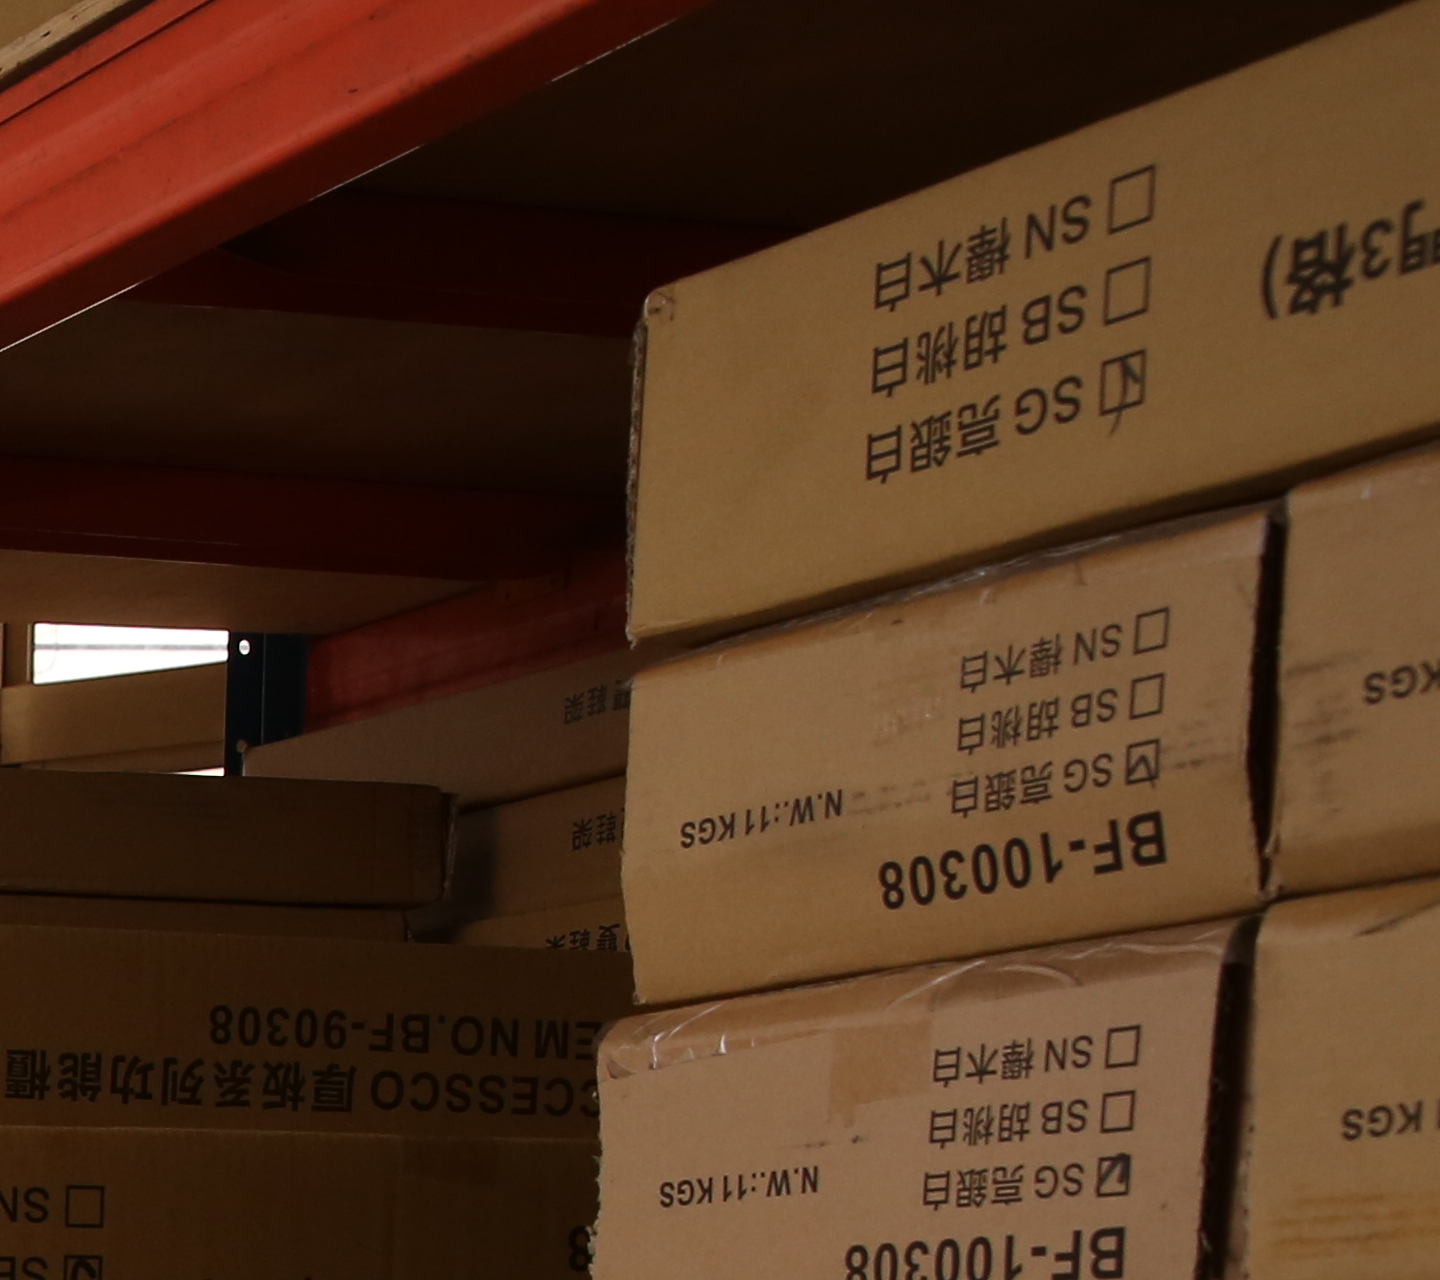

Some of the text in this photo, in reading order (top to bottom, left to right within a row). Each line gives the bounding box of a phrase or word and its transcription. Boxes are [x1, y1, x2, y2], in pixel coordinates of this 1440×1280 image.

[1025, 195, 1091, 259] SN
[872, 285, 1086, 397] SB 胡桃白
[866, 376, 1082, 484] SG 亮銀白
[681, 813, 735, 848] KGS
[879, 811, 1166, 909] BF-100308
[209, 1005, 519, 1058] NO.BF-90308
[1045, 1035, 1093, 1072] SN
[4, 1049, 357, 1113] 厚板系列功能櫃
[368, 1065, 604, 1121] CCESSCO
[929, 1099, 1088, 1149] SB 胡桃白
[1342, 1101, 1422, 1141] KGS
[660, 1177, 713, 1208] KGS
[923, 1163, 1084, 1211] SG 亮銀白
